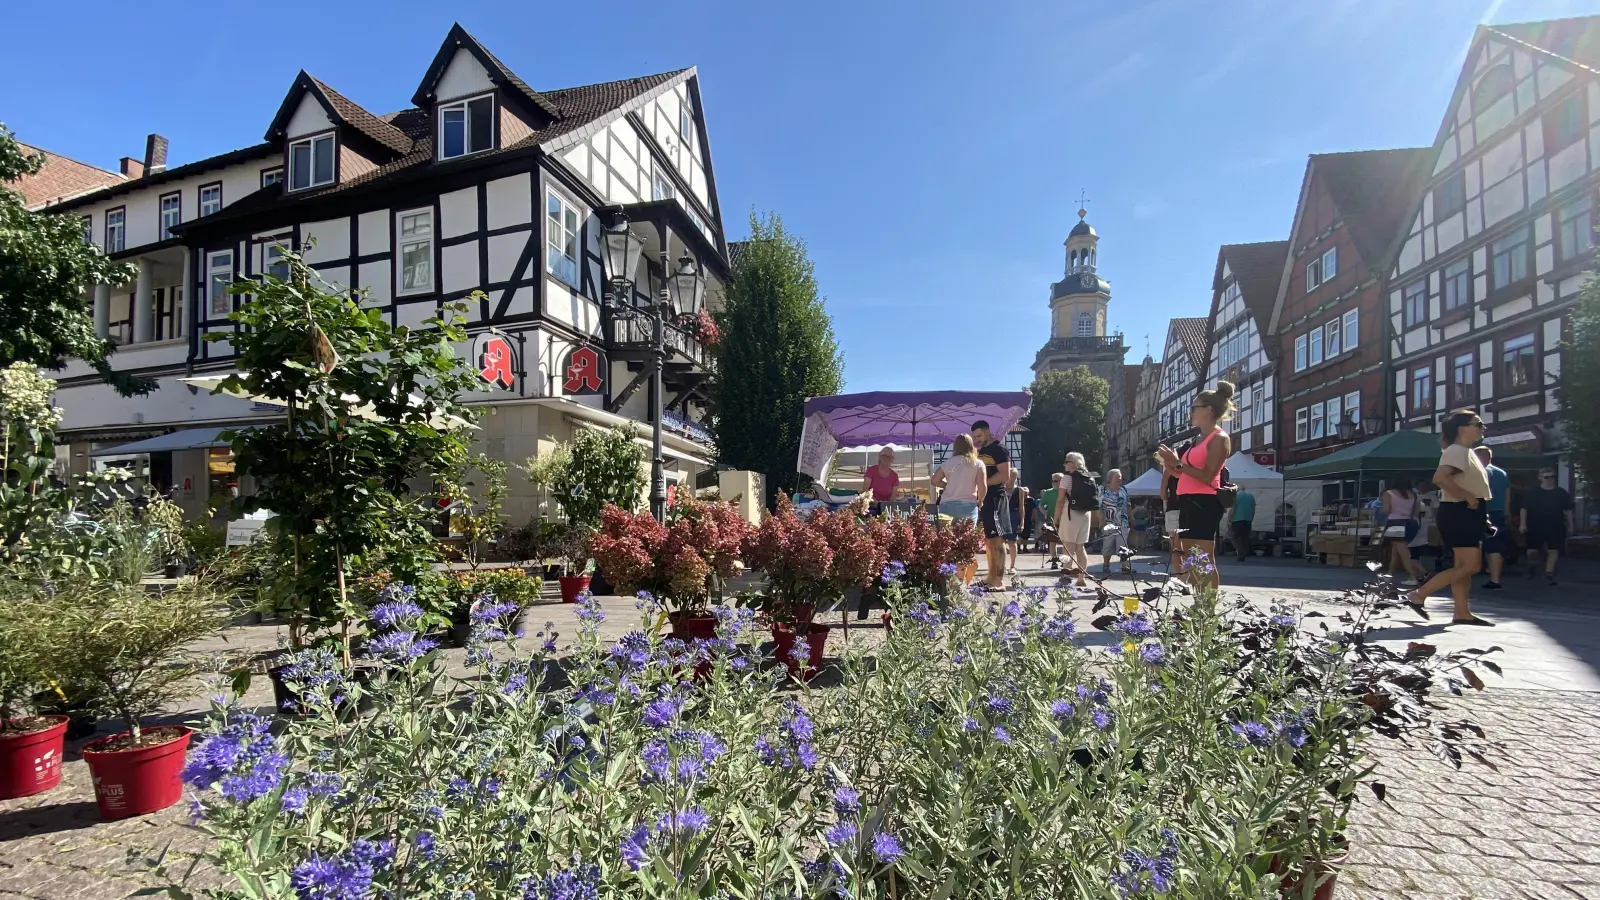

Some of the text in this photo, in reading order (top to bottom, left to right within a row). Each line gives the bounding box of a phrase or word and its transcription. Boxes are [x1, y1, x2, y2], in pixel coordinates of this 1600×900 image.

[478, 337, 515, 387] A
[562, 346, 604, 393] A
[102, 788, 125, 796] PLUS
